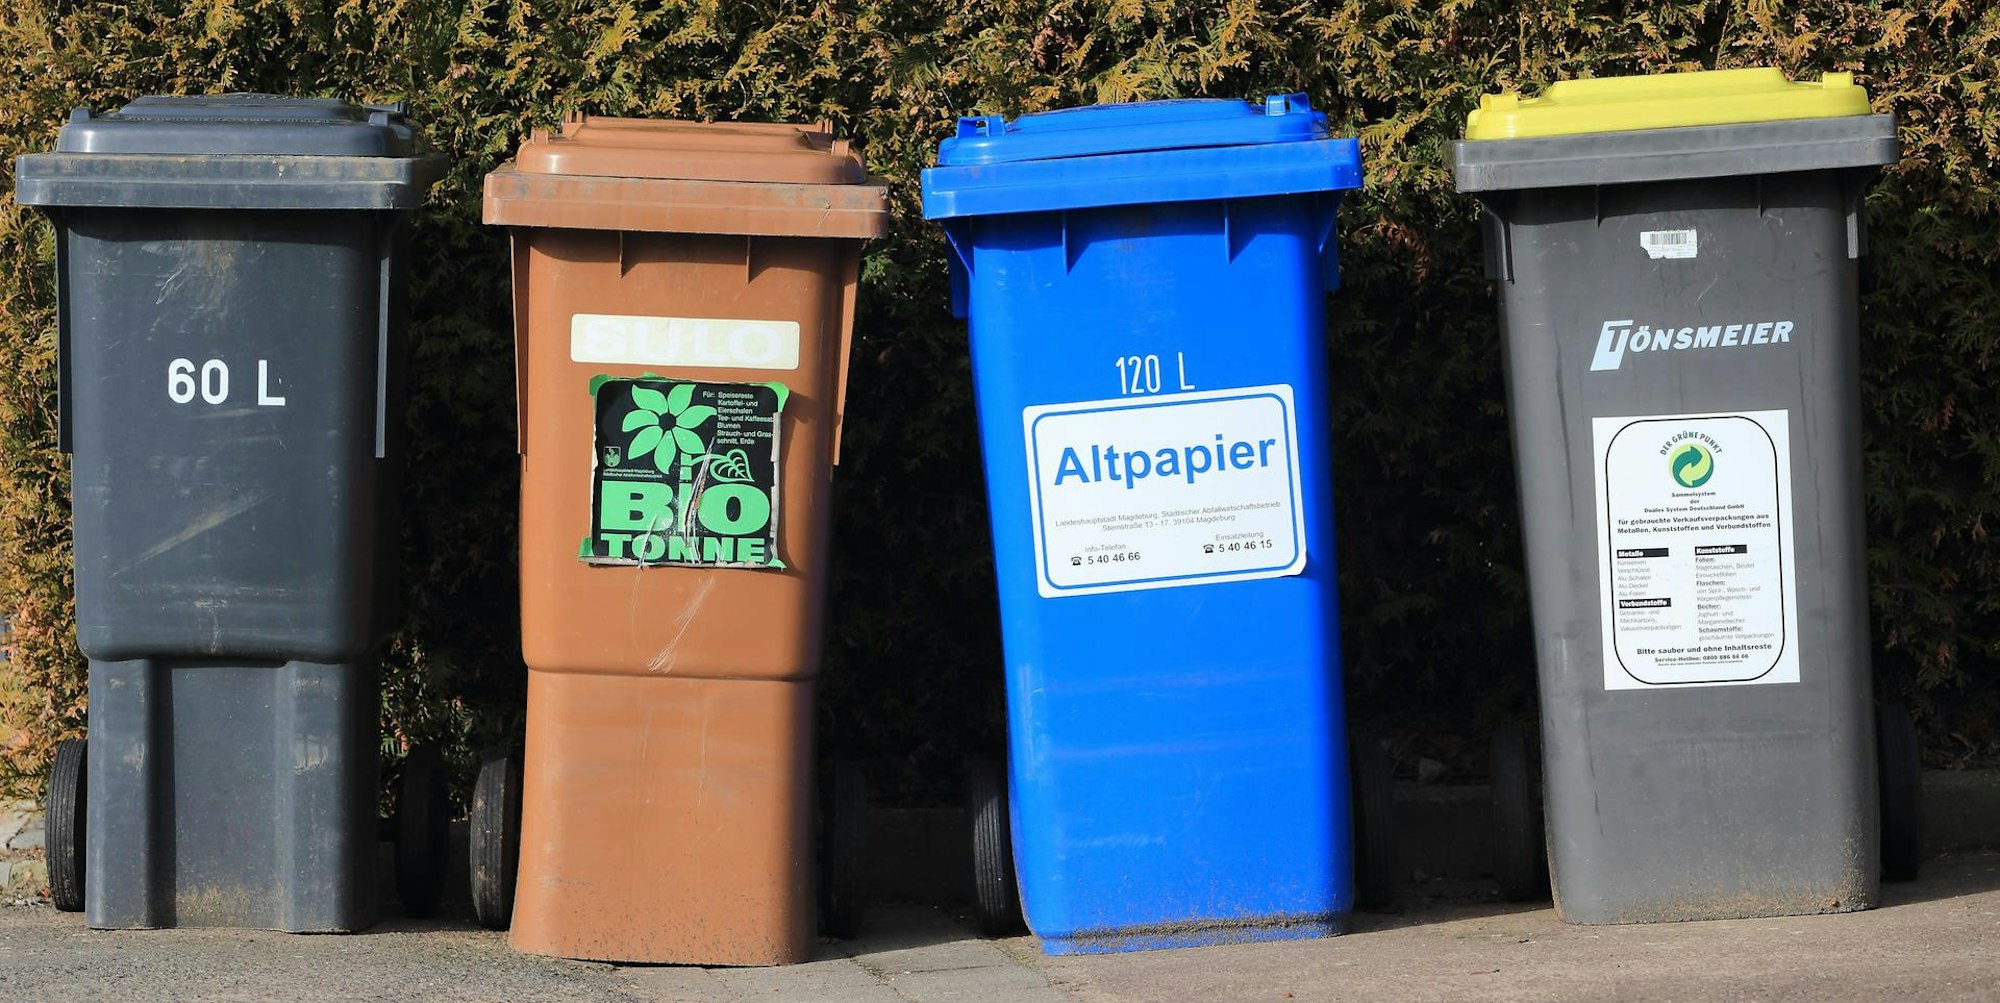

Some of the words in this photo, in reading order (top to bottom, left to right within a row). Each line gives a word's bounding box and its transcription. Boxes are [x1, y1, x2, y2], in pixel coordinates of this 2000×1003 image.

[585, 318, 782, 365] SULO
[1590, 319, 1794, 371] TÖNSMEIER
[168, 358, 229, 404] 60
[257, 360, 286, 406] L
[1115, 354, 1161, 395] 120
[1178, 352, 1195, 390] L
[1660, 440, 1673, 456] DER
[1700, 432, 1723, 454] PUNKT
[1054, 434, 1276, 490] Altpapier
[1056, 515, 1116, 527] Landeshauptstadt
[1202, 500, 1281, 514] Abfallwirtschaftsbetrieb
[1144, 521, 1154, 529] 13
[1173, 518, 1196, 526] 39104
[1196, 514, 1236, 526] Magdeburg
[1630, 517, 1672, 526] gebrauchte
[1673, 514, 1755, 524] Verkaufsverpackungen
[1215, 531, 1264, 542] Einsatzleitung
[1618, 526, 1651, 534] Metallen,
[1652, 524, 1700, 533] Kunststoffen
[1716, 522, 1772, 530] Verbundstoffen
[601, 534, 765, 562] TONNE
[1084, 543, 1126, 553] Info-Telefon
[1218, 544, 1225, 553] 5
[1228, 542, 1240, 552] 40
[1244, 541, 1256, 550] 46
[1260, 539, 1272, 549] 15
[1088, 556, 1094, 565] 5
[1096, 554, 1110, 564] 40
[1112, 553, 1126, 563] 46
[1128, 552, 1141, 562] 66
[1724, 644, 1772, 652] Inhaltsreste
